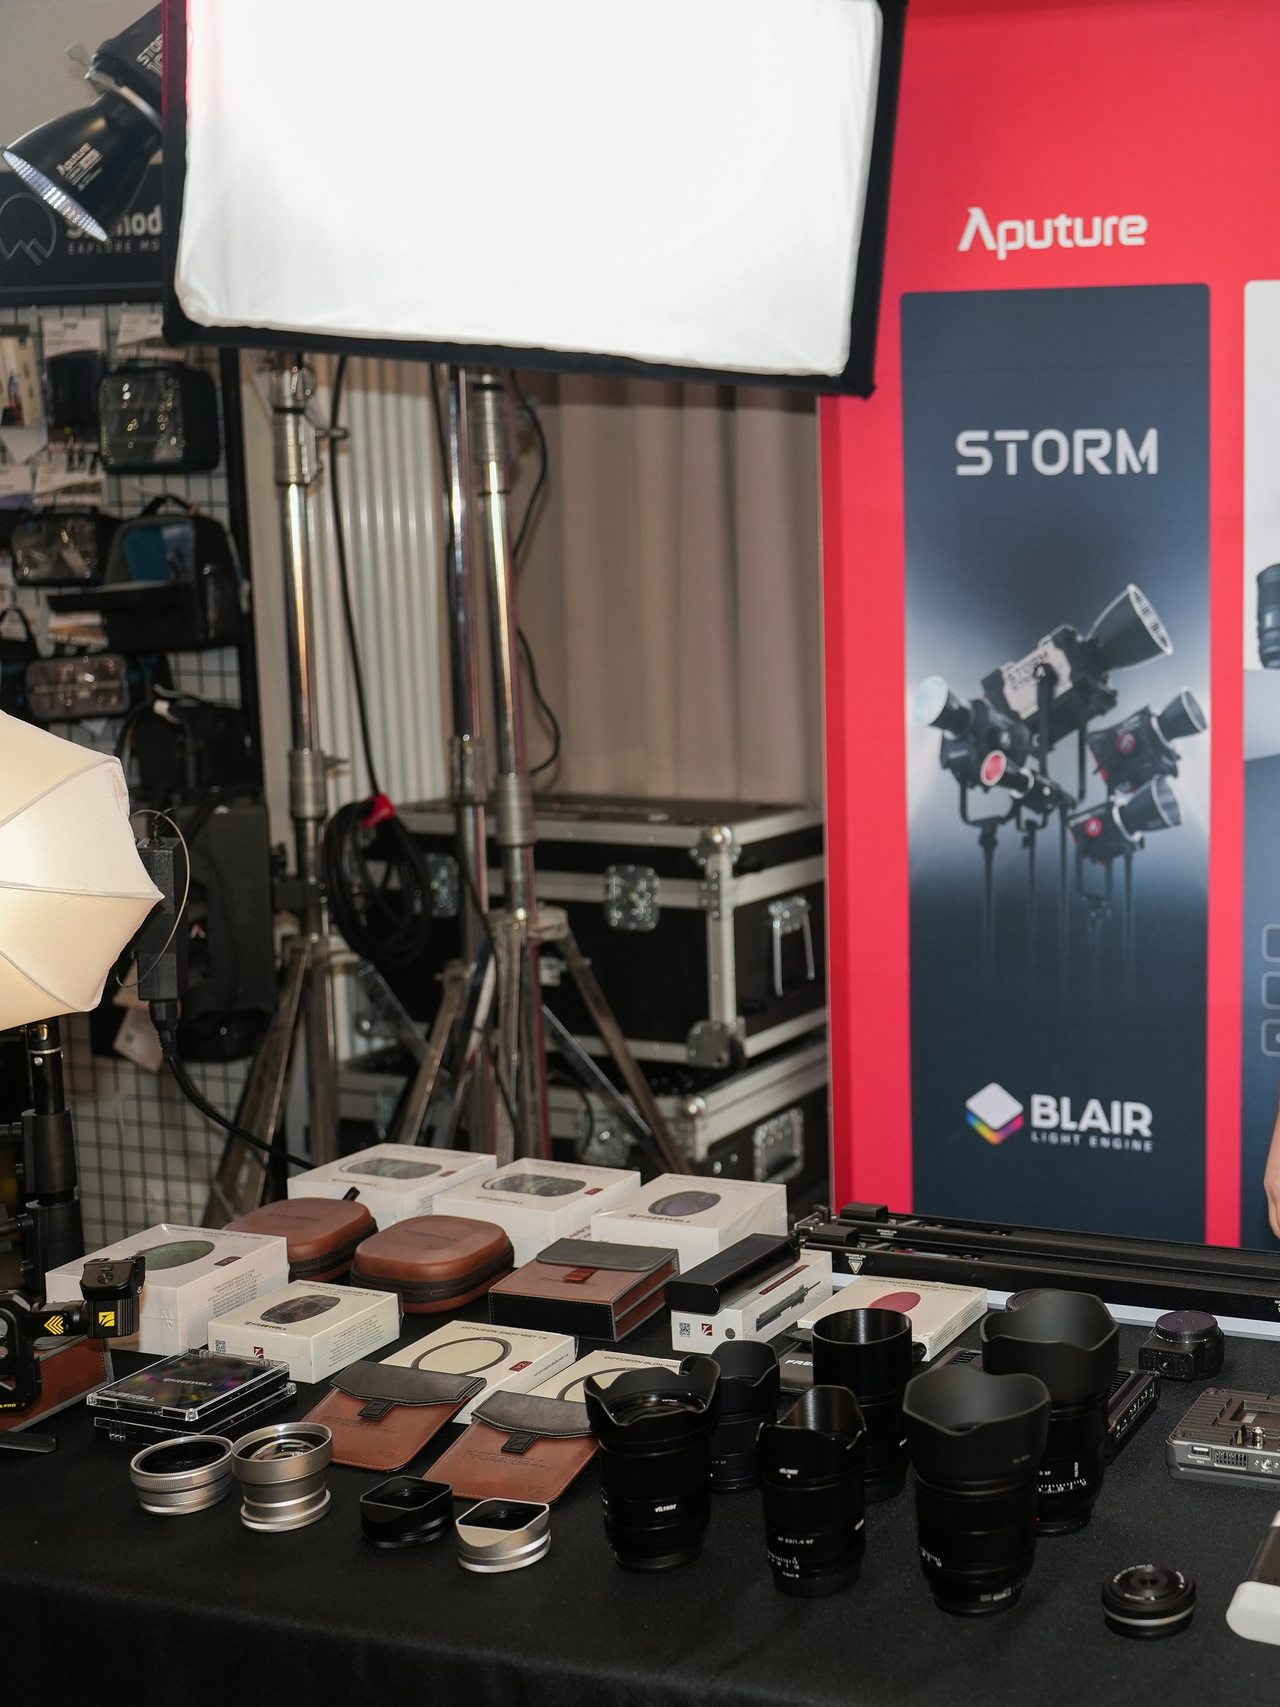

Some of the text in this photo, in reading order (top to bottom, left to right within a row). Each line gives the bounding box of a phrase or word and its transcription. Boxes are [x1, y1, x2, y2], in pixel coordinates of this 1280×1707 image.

[957, 207, 1148, 259] Aputure
[955, 427, 1159, 476] STORM
[1030, 1093, 1153, 1137] BLAIR
[1030, 1131, 1153, 1152] LIGHT ENGINE
[637, 1214, 693, 1224] FREEWELL
[604, 1355, 643, 1364] DIFFUSION
[461, 1449, 547, 1468] FREEWELL
